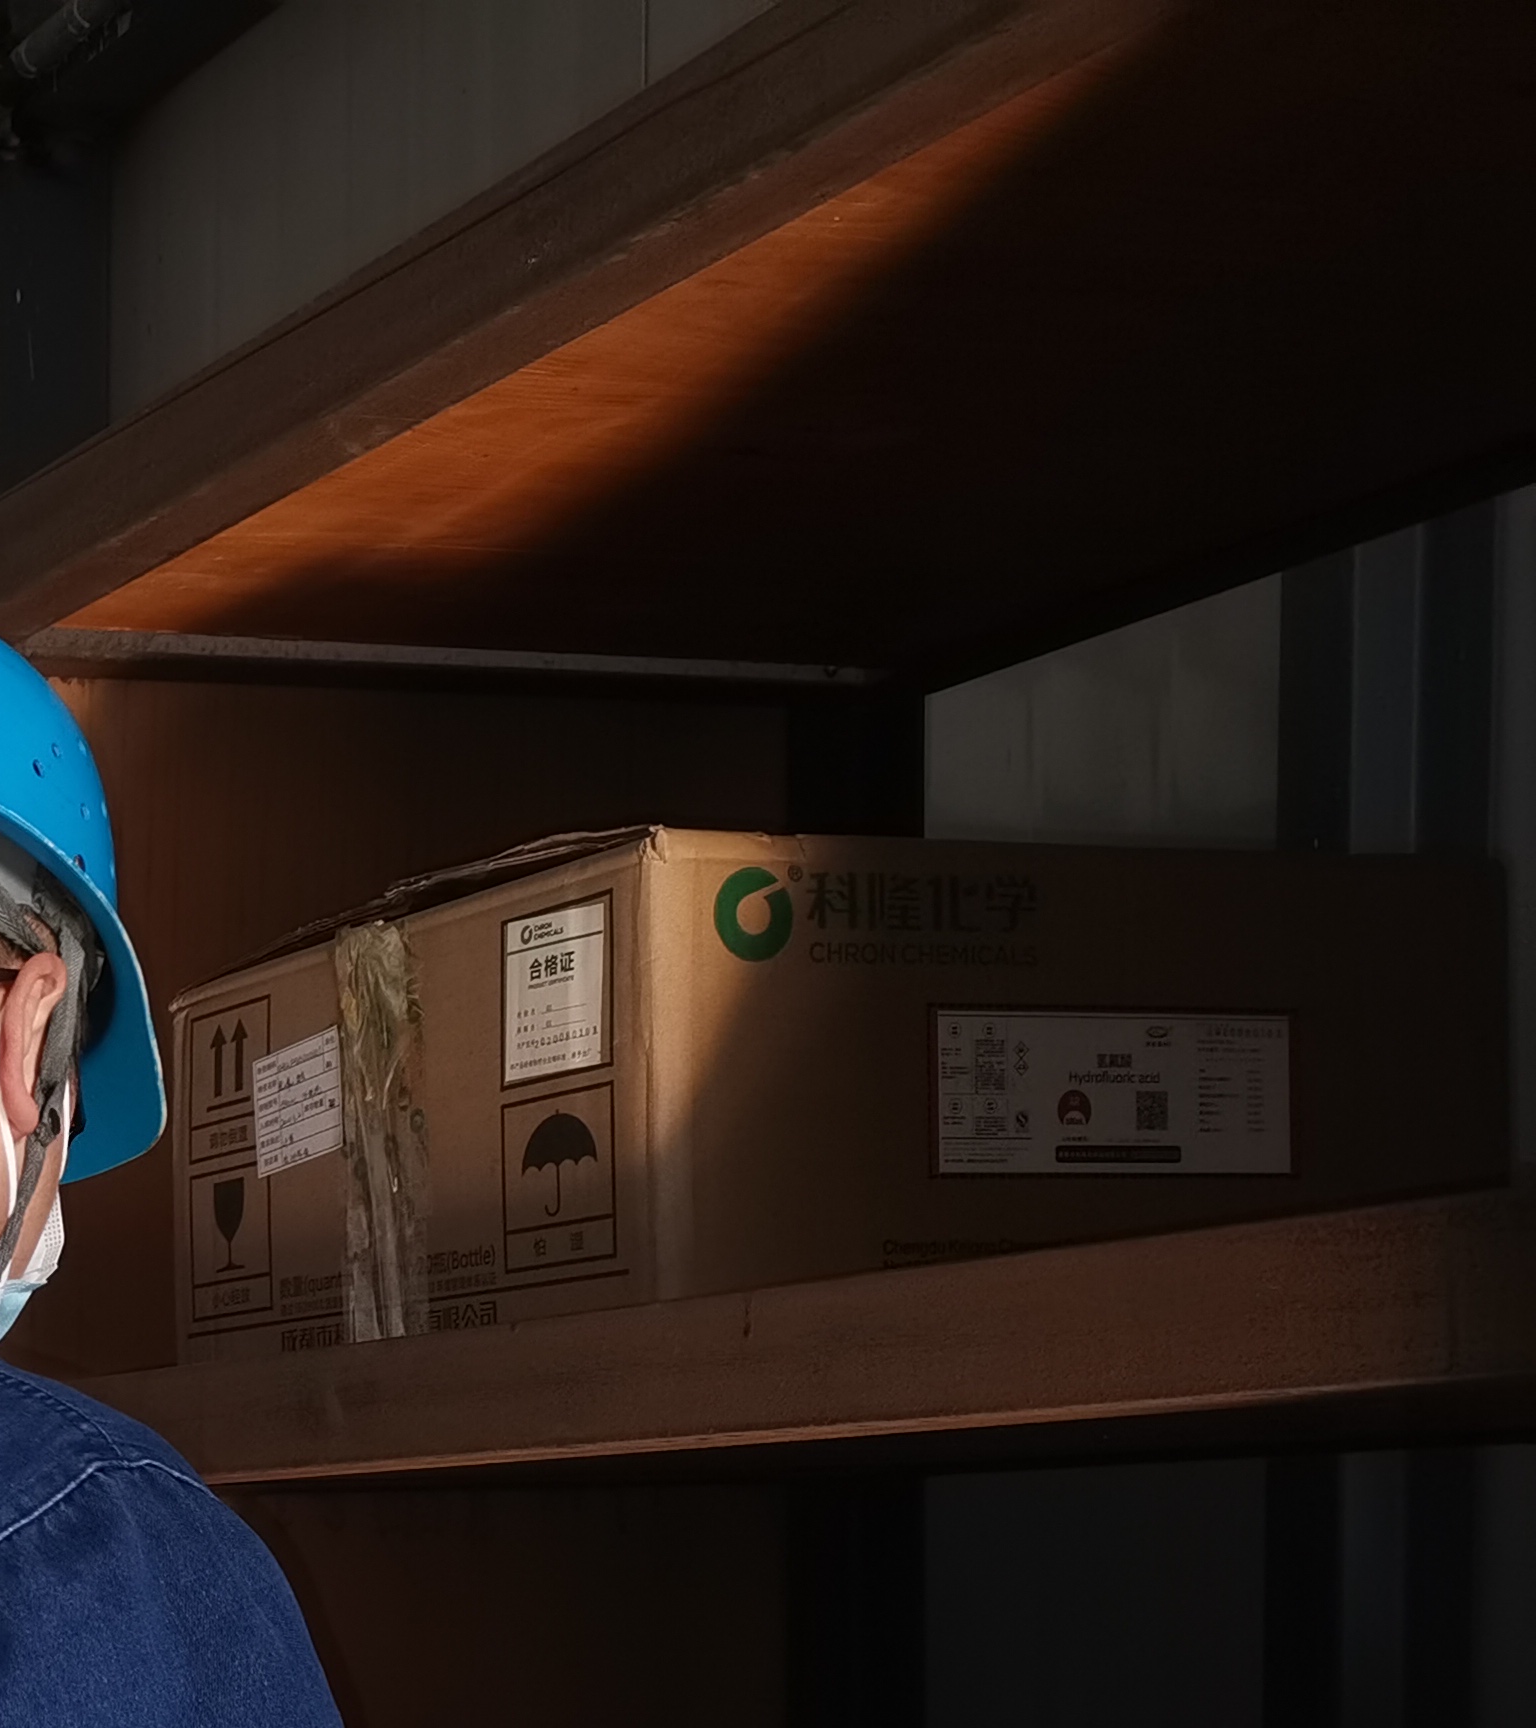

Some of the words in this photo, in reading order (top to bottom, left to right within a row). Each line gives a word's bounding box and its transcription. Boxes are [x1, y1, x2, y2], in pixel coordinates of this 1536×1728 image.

[806, 870, 1038, 934] 科隆化学
[529, 951, 575, 982] 合格证
[808, 942, 896, 966] CHRON
[900, 943, 1039, 968] CHEMICALS
